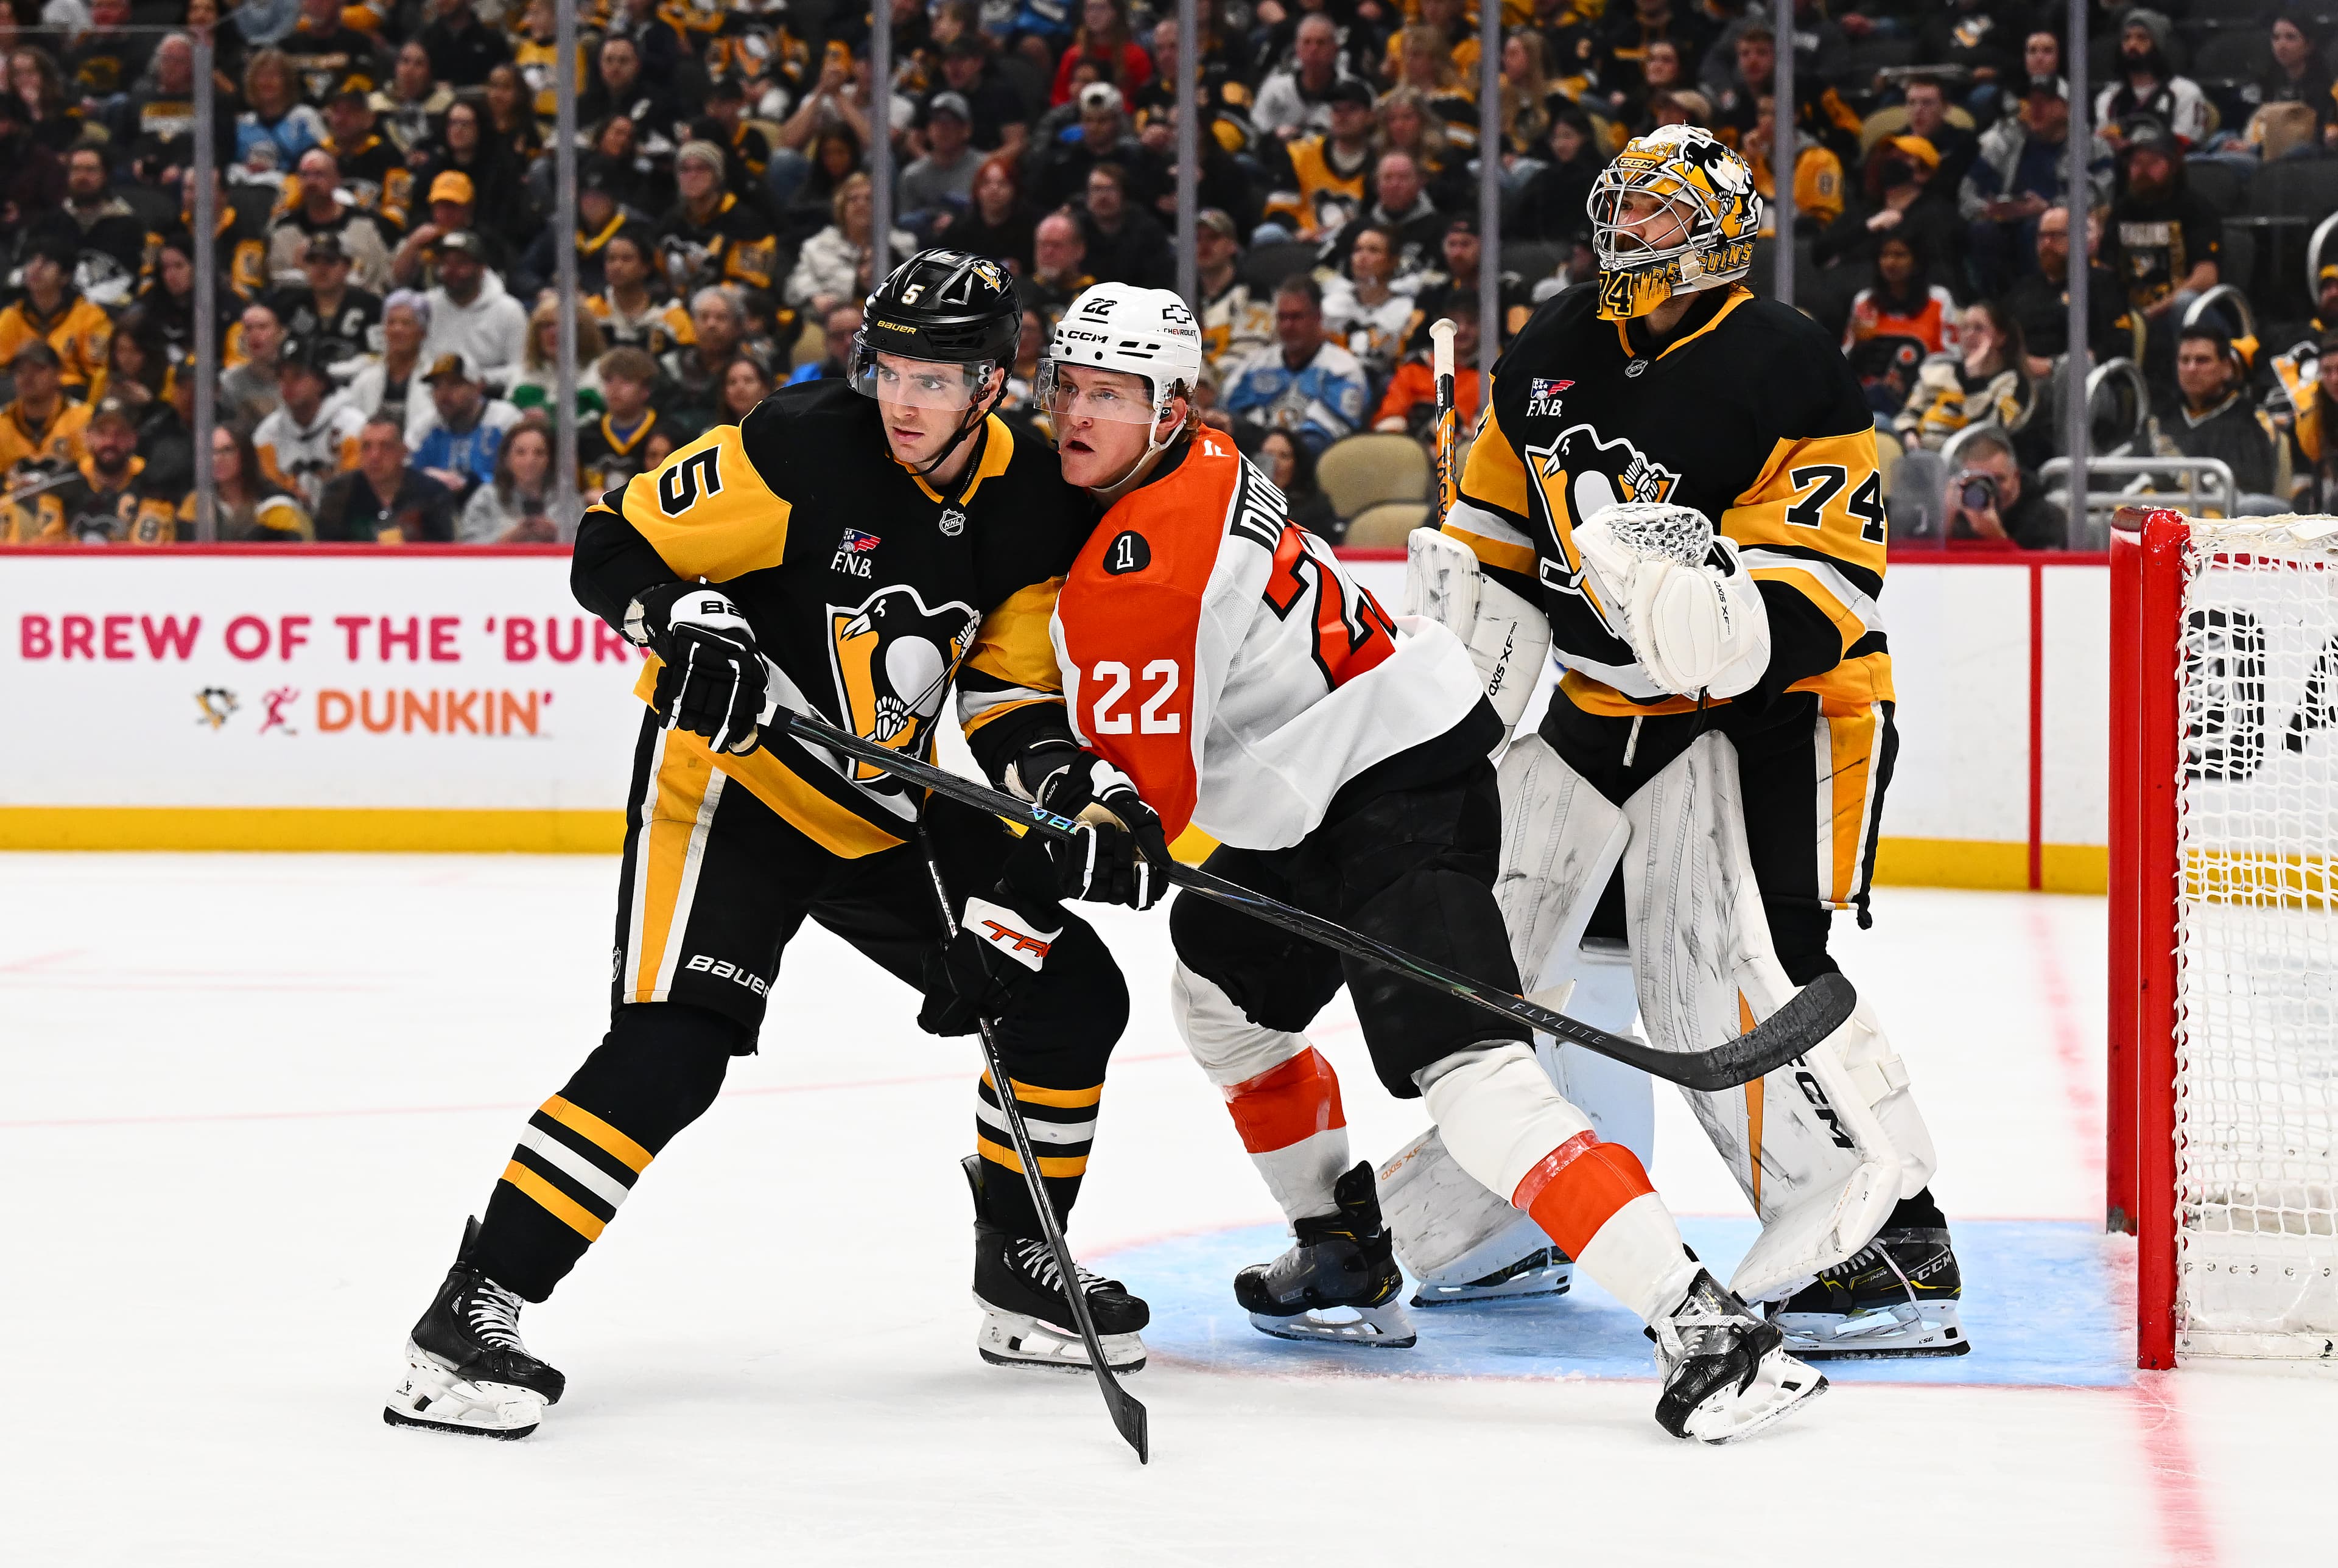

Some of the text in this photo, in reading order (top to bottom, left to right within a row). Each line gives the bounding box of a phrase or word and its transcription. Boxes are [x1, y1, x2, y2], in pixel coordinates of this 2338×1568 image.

[1618, 158, 1657, 169] CCM
[900, 284, 925, 305] 5
[1082, 298, 1118, 316] 22
[877, 320, 917, 335] BAUER
[1067, 330, 1109, 344] CCM
[1164, 327, 1196, 337] CHEVROLET
[1526, 399, 1563, 417] F.N.B.
[657, 443, 725, 519] 5
[1785, 464, 1886, 546] 74
[944, 517, 961, 529] NHL
[830, 550, 872, 579] F.N.B.
[1117, 535, 1134, 570] 1
[20, 614, 653, 663] BREW OF THE 'BUR
[1092, 659, 1180, 734] 22
[317, 688, 553, 735] DUNKIN'
[1045, 780, 1058, 804] MACH
[1511, 1002, 1607, 1045] FLYLITE
[1916, 1255, 1953, 1281] CCM
